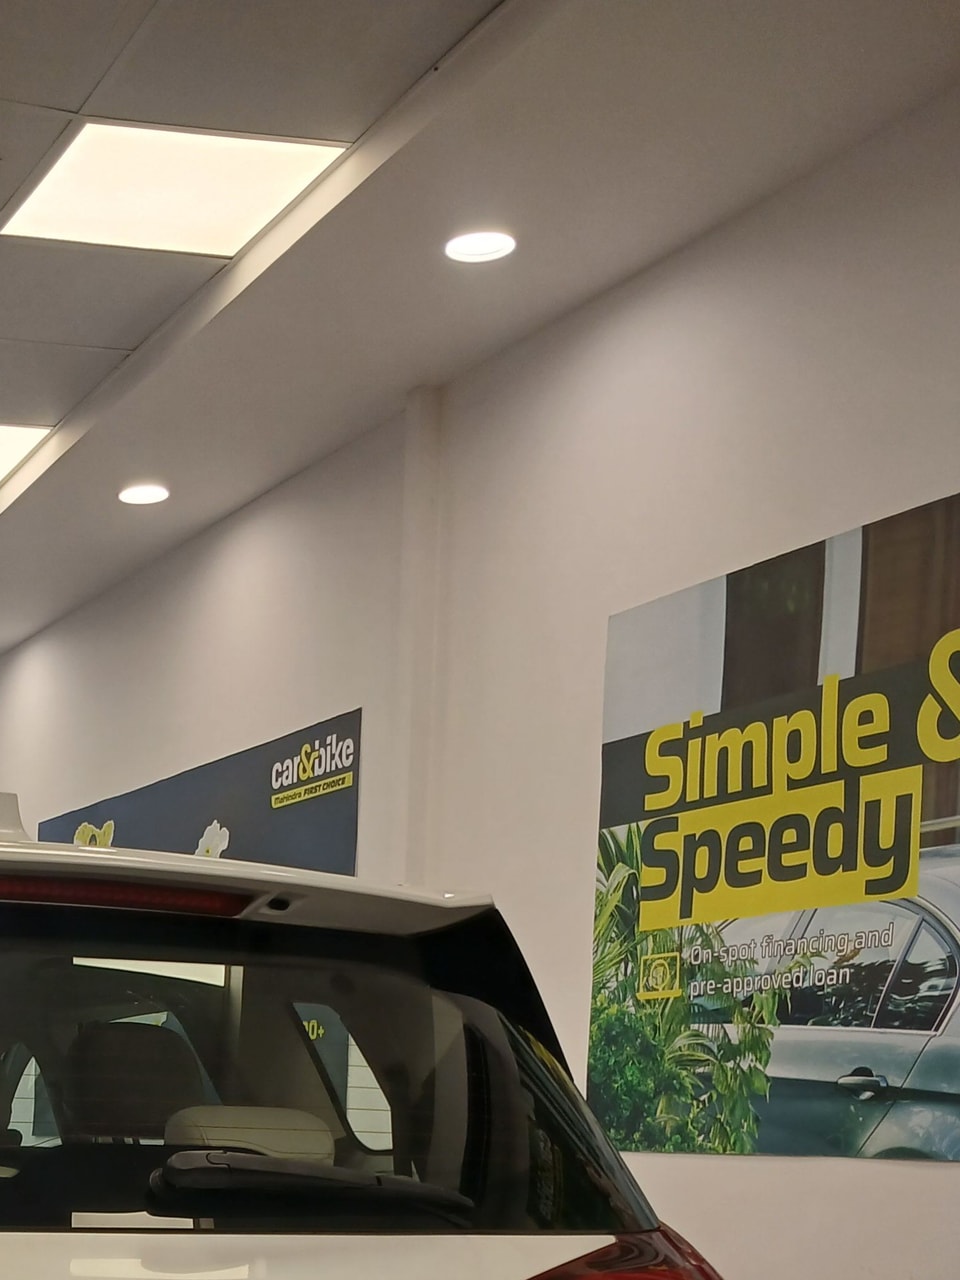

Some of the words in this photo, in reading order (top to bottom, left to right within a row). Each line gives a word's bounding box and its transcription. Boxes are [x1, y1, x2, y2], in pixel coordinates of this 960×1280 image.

[271, 733, 354, 790] car&bike
[643, 673, 891, 812] Simple
[303, 785, 322, 797] FIRST
[640, 782, 913, 920] Speedy
[690, 939, 756, 966] On-spot
[760, 927, 849, 958] financing
[853, 921, 895, 949] and
[690, 963, 803, 1000] pre-approved
[808, 964, 852, 987] loan
